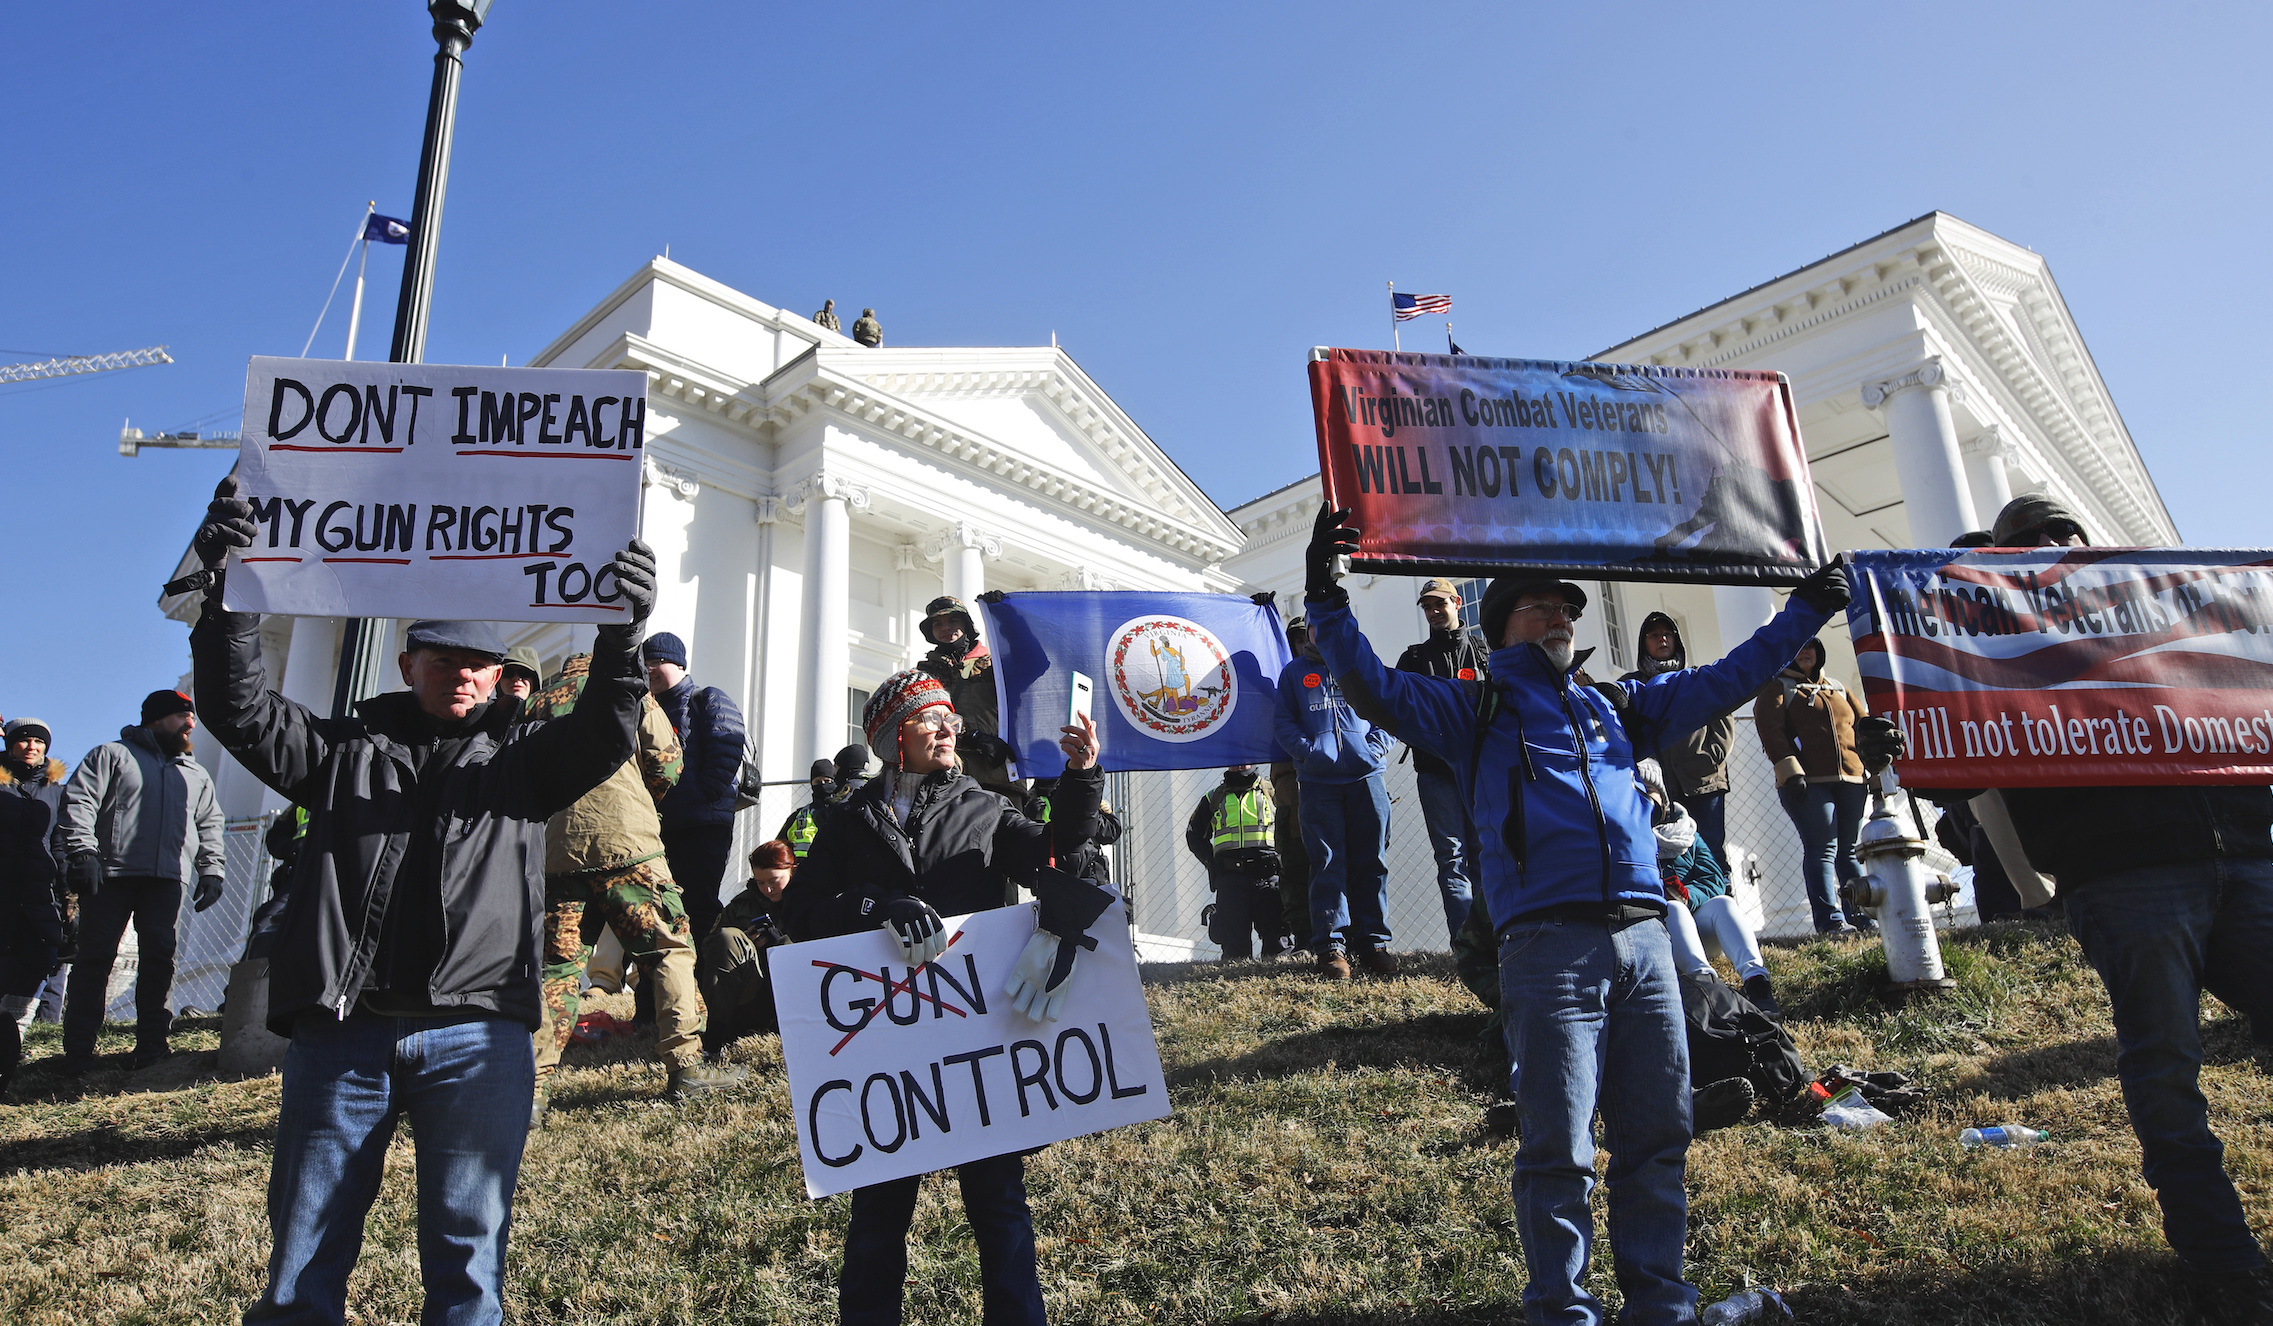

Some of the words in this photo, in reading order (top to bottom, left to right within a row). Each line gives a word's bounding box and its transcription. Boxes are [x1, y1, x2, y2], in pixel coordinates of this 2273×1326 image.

[451, 386, 646, 449] IMPEACH
[1339, 384, 1454, 438] Virginian
[1460, 388, 1557, 430] Combat
[1562, 391, 1668, 436] Veterans
[1352, 445, 1443, 495] WILL
[1449, 446, 1521, 498] NOT
[1533, 446, 1682, 505] COMPLY!
[248, 496, 316, 548] MY
[315, 500, 416, 553] GUN
[426, 504, 574, 554] RIGHTS
[523, 561, 621, 604] TOO
[2014, 570, 2172, 636] Veterans
[2171, 570, 2212, 634] of
[1143, 628, 1187, 639] VIRGINIA
[1183, 702, 1215, 723] TYRANNIS
[1882, 706, 1956, 761] Will
[1961, 711, 2020, 759] not
[2021, 704, 2152, 757] tolerate
[820, 954, 987, 1033] GUN
[809, 1022, 1146, 1168] CONTROL
